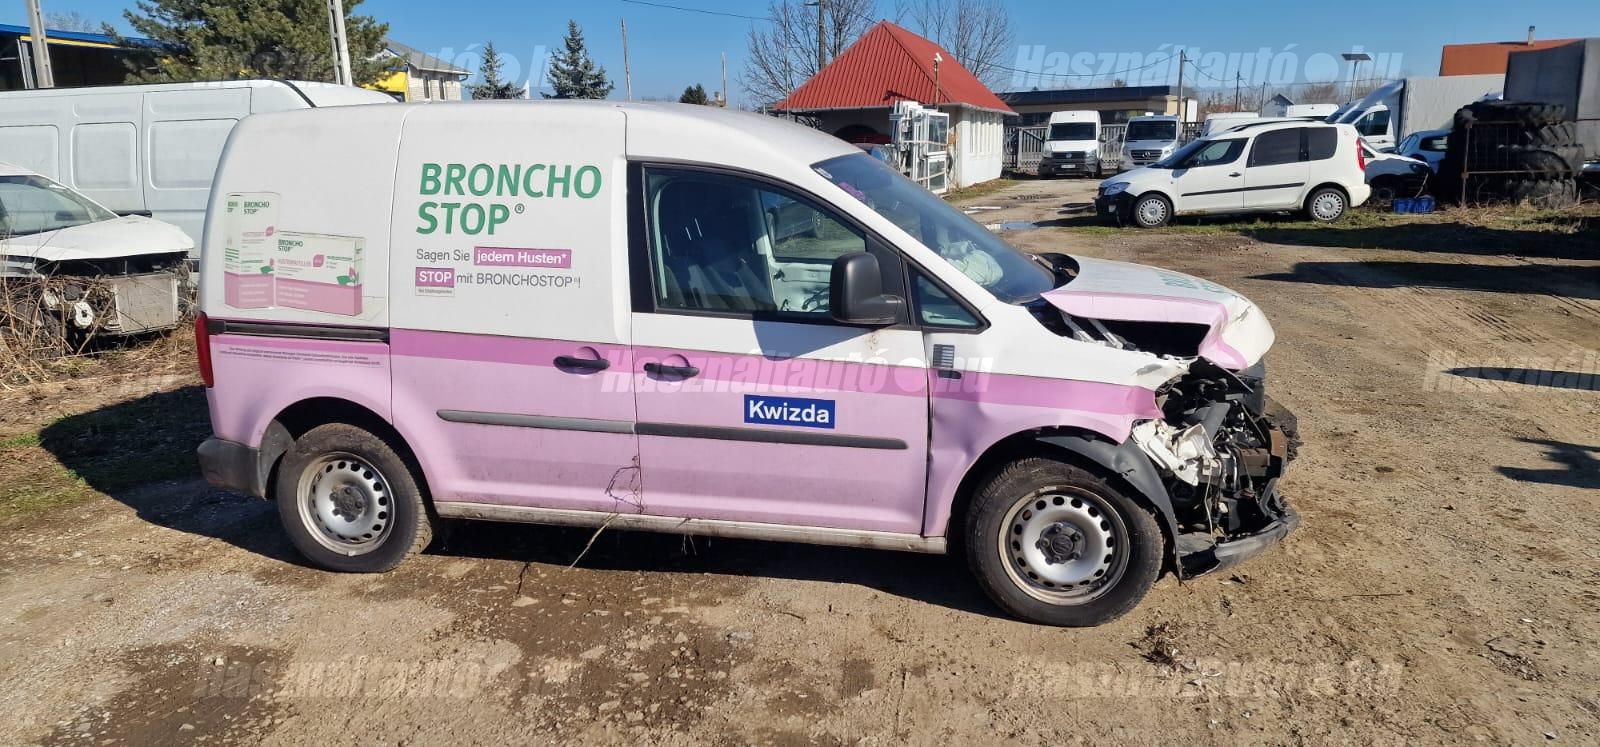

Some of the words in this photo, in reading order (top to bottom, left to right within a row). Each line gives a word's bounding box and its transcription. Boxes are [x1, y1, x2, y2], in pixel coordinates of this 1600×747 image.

[419, 163, 602, 199] BRONCHO
[416, 201, 511, 236] STOP
[416, 248, 450, 263] Sagen
[453, 249, 470, 262] Sie
[477, 250, 515, 264] jedem
[419, 270, 452, 284] STOP
[456, 272, 473, 284] mit
[749, 399, 830, 424] Kwizda
